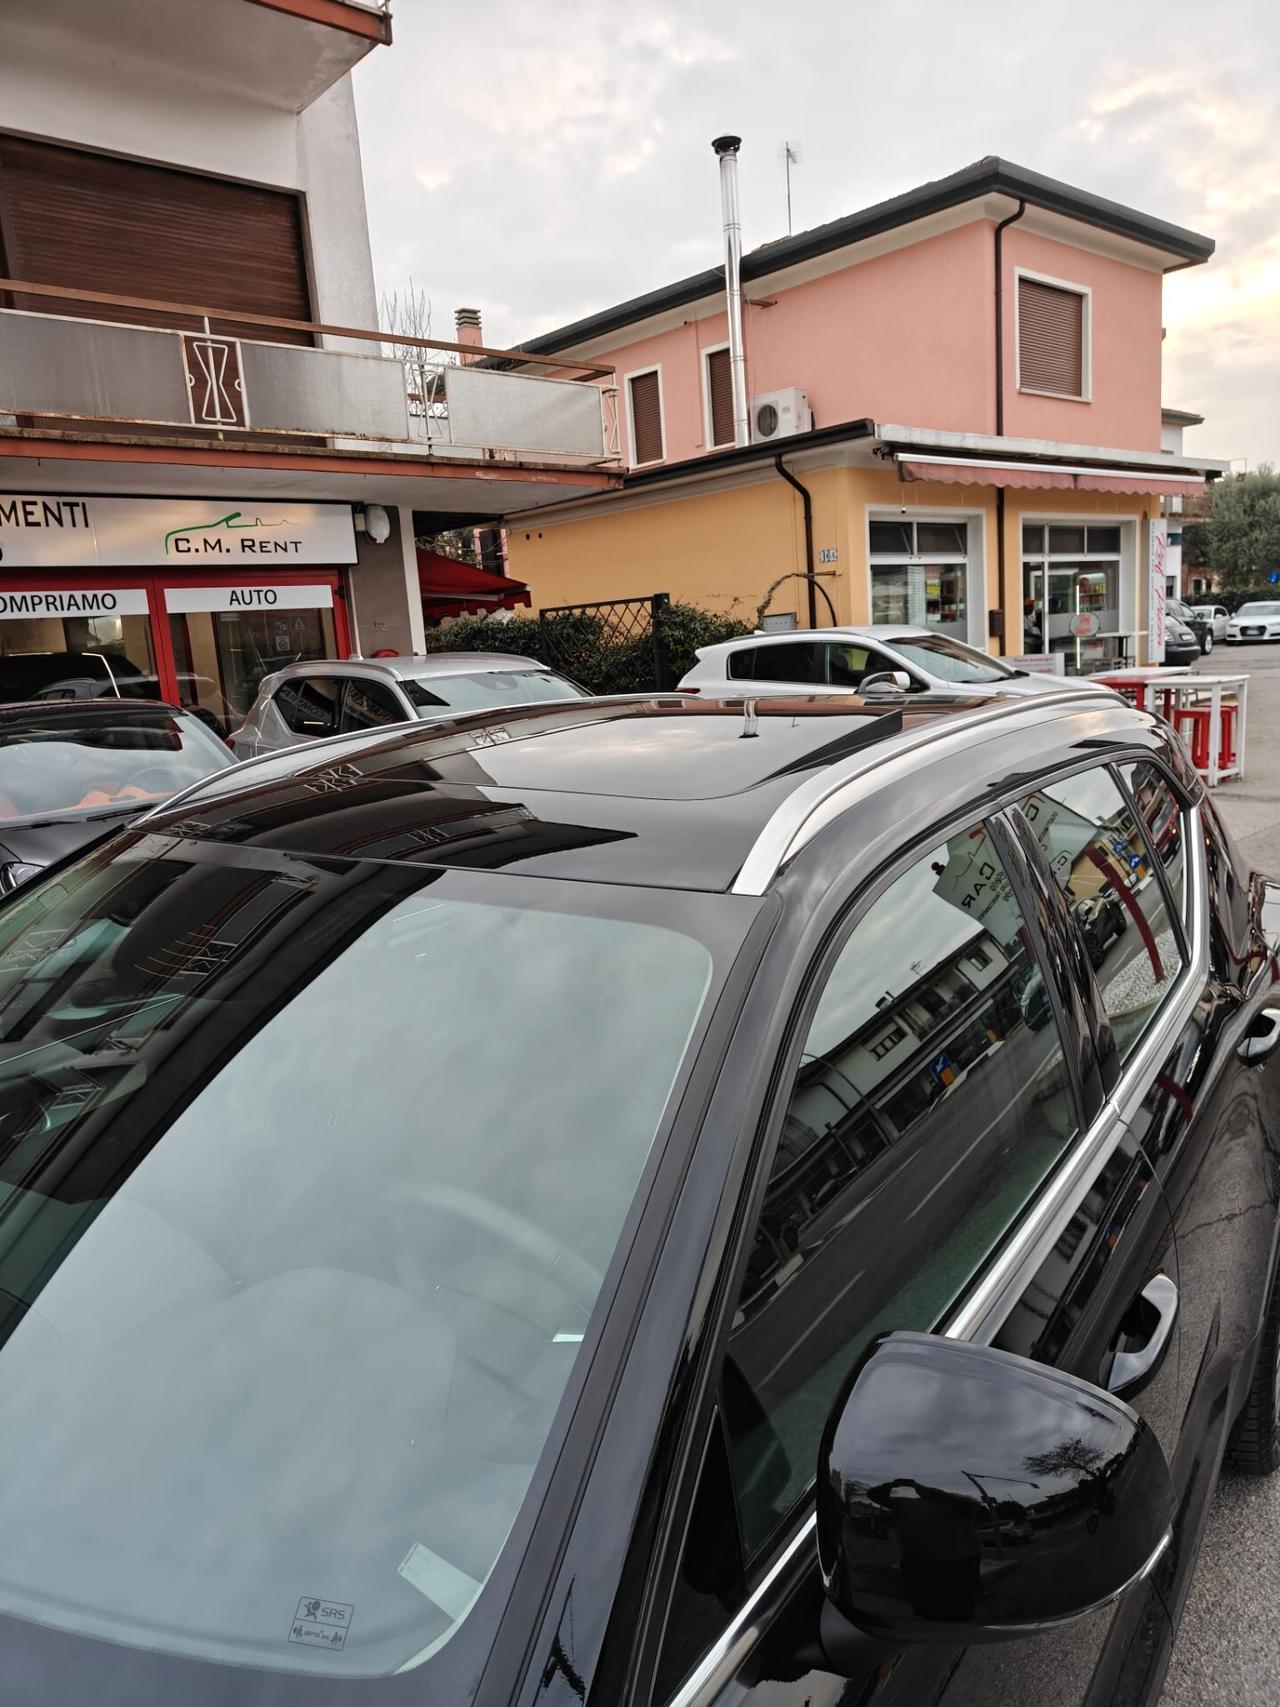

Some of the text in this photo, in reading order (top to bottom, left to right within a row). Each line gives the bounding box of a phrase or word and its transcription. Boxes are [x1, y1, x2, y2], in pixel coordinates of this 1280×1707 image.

[0, 500, 89, 528] MENTI
[174, 538, 302, 553] C.M. RENT
[229, 589, 277, 606] AUTO
[320, 1607, 346, 1620] SRS
